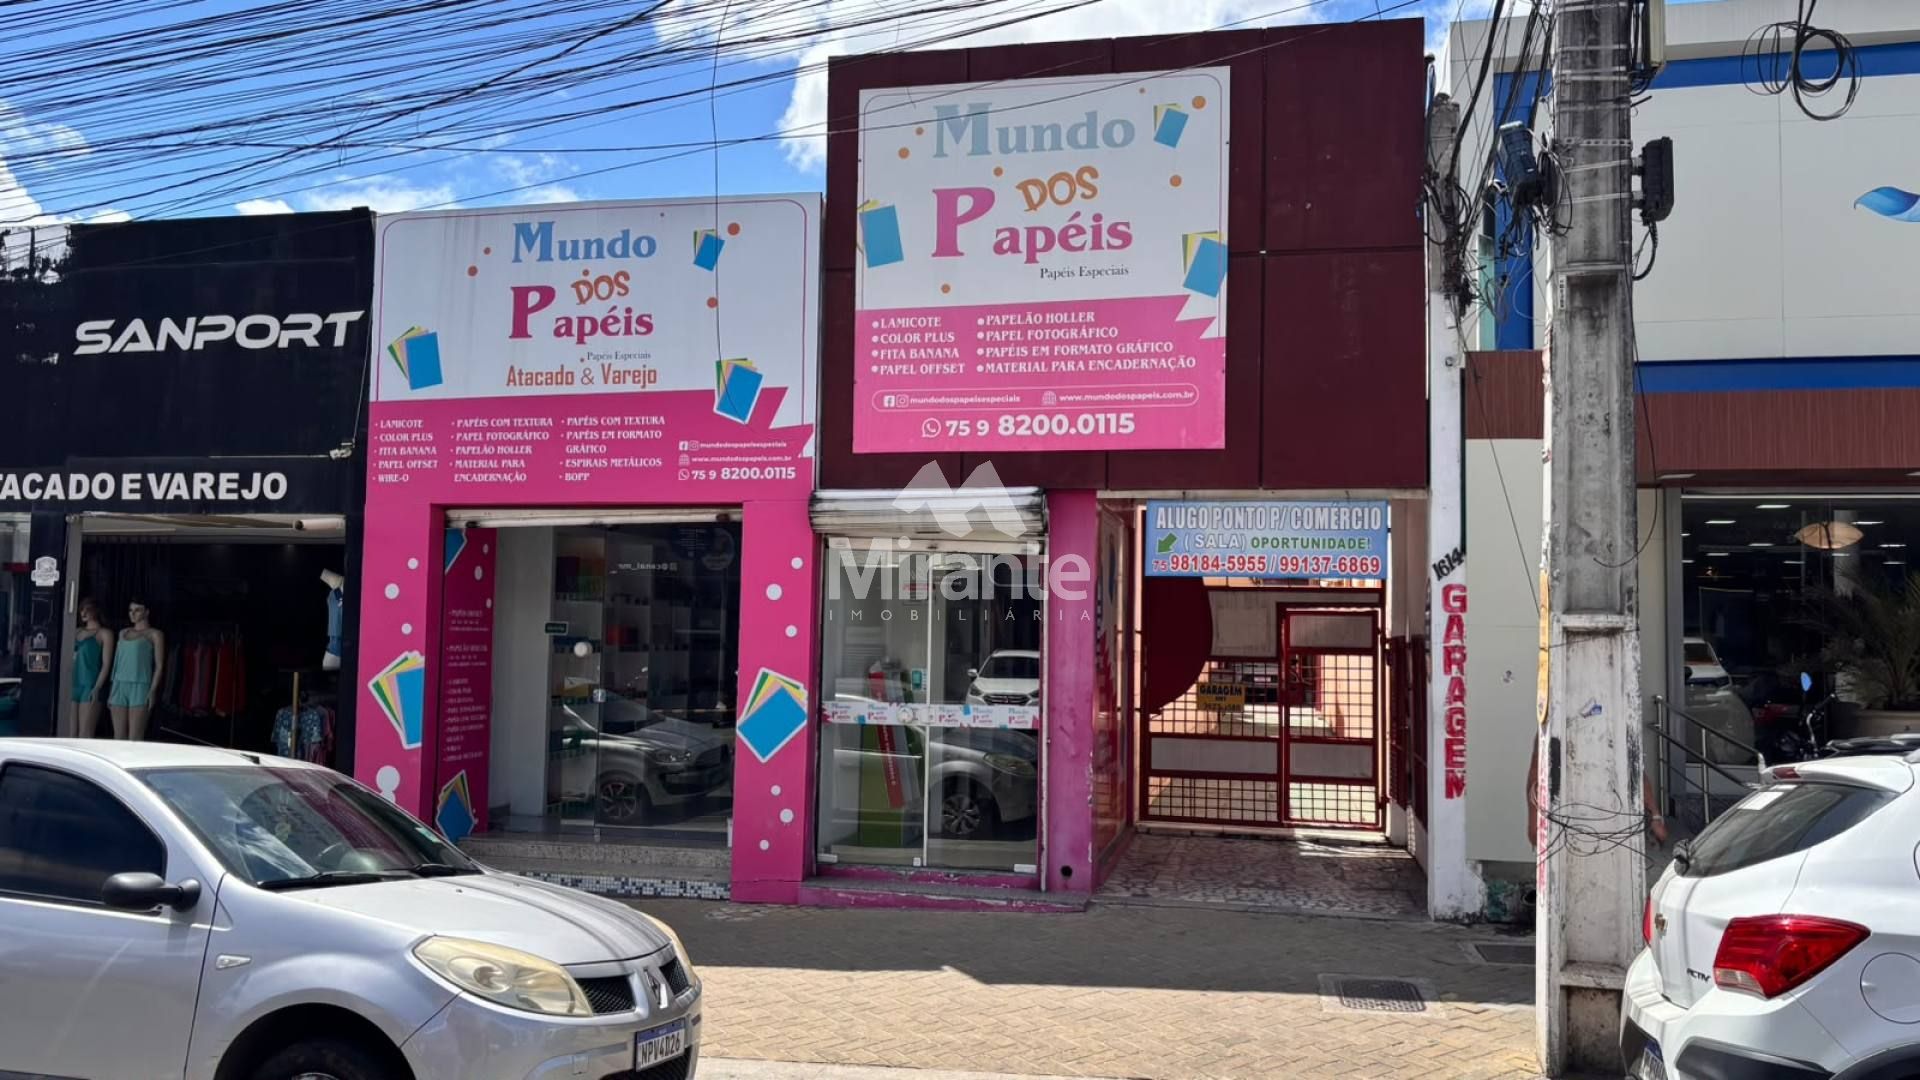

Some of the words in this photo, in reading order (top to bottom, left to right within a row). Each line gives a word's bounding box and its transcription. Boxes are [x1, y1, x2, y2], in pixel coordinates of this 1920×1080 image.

[933, 102, 1136, 158] Mundo
[1015, 165, 1099, 212] DOS
[931, 187, 1134, 264] Papéis
[511, 222, 657, 263] Mundo
[1040, 266, 1076, 281] Papéis
[1079, 264, 1130, 280] Especiais
[571, 270, 631, 305] DOS
[508, 285, 655, 344] Papéis
[986, 311, 1043, 326] PAPELÃO
[880, 317, 942, 329] LAMICOTE
[73, 310, 365, 355] SANPORT
[880, 333, 921, 344] COLOR
[925, 332, 955, 343] PLUS
[986, 330, 1024, 342] PAPEL
[1027, 326, 1119, 340] FOTOGRÁFICO
[880, 349, 906, 360] FITA
[910, 347, 960, 359] BANANA
[985, 344, 1028, 358] PAPÉIS
[1032, 347, 1050, 357] EM
[1054, 344, 1113, 356] FORMATO
[1116, 340, 1174, 354] GRÁFICO
[880, 364, 917, 375] PAPEL
[920, 363, 966, 375] OFFSET
[985, 361, 1048, 374] MATERIAL
[1051, 360, 1085, 372] PARA
[1088, 355, 1196, 372] ENCADERNAÇÃO
[506, 364, 575, 387] Atacado
[581, 367, 595, 386] &
[601, 362, 657, 389] Varejo
[380, 419, 424, 429] LAMICOTE
[490, 418, 511, 427] COM
[513, 417, 553, 427] TEXTURA
[600, 416, 621, 426] COM
[624, 416, 665, 425] TEXTURA
[945, 420, 971, 437] 75
[976, 420, 990, 436] 9
[997, 413, 1135, 436] 8200.0115
[379, 433, 409, 442] COLOR
[411, 432, 433, 442] PLUS
[456, 432, 482, 442] PAPEL
[486, 430, 550, 441] FOTOGRÁFICO
[601, 430, 615, 440] EM
[617, 430, 662, 439] FORMATO
[379, 447, 397, 456] FITA
[400, 446, 437, 456] BANANA
[378, 460, 404, 469] PAPEL
[406, 460, 438, 469] OFFSET
[454, 459, 499, 469] MATERIAL
[501, 459, 526, 468] PARA
[565, 458, 608, 468] ESPIRAIS
[610, 456, 662, 467] METÁLICOS
[691, 470, 706, 480] 75
[709, 470, 717, 480] 9
[721, 467, 796, 480] 8200.0115
[0, 472, 115, 500] ACADO
[121, 472, 142, 499] E
[147, 472, 288, 500] VAREJO
[1156, 507, 1208, 529] ALUGO
[1211, 506, 1266, 529] PONTO
[1270, 506, 1288, 530] P/
[1290, 502, 1382, 530] COMÉRCIO
[1251, 536, 1371, 550] OPORTUNIDADE!
[1152, 559, 1168, 572] 75
[1170, 554, 1267, 573] 98184-5955
[1279, 555, 1381, 574] 99137-6869
[1432, 547, 1465, 581] 1614
[1441, 583, 1468, 800] GARAGEM
